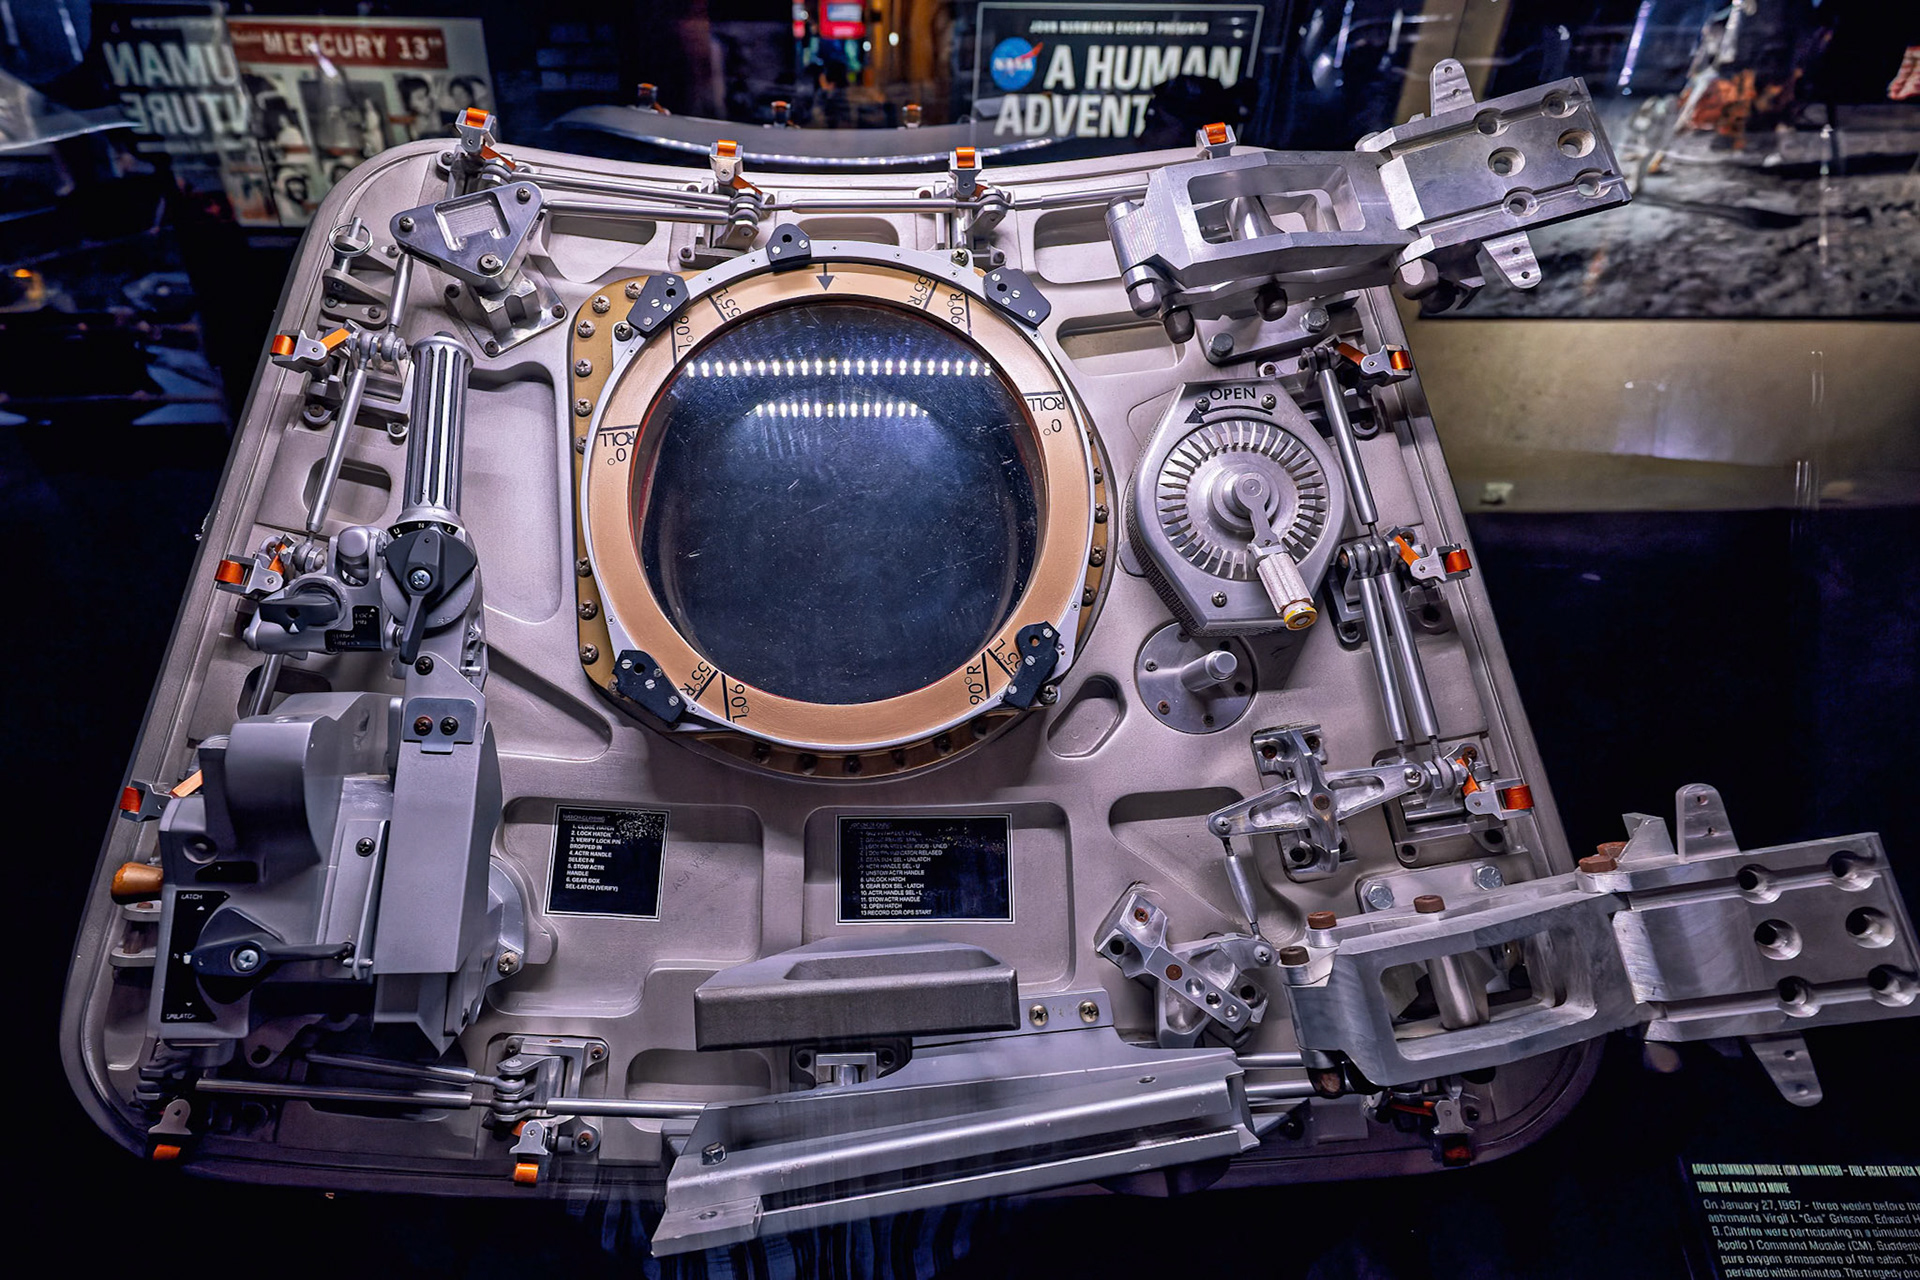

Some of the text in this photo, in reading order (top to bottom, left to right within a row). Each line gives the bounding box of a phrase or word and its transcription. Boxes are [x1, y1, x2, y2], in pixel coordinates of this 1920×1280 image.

[262, 31, 387, 59] MERCURY
[993, 56, 1033, 71] NASA
[1043, 44, 1242, 91] A HUMAN
[1209, 387, 1256, 400] OPEN
[1027, 396, 1065, 411] ROLL
[599, 430, 635, 447] ROLL
[1692, 1163, 1718, 1175] APOLLO
[1717, 1163, 1755, 1175] COMMAND
[1754, 1164, 1783, 1176] MODULE
[1818, 1165, 1843, 1176] HATCH
[1887, 1165, 1917, 1177] REPLICA
[1696, 1181, 1718, 1193] FROM
[1717, 1181, 1732, 1193] THE
[1731, 1182, 1759, 1193] APOLLO
[1766, 1182, 1791, 1194] MOVIE
[1703, 1199, 1718, 1210] On
[1720, 1199, 1759, 1211] January
[1778, 1199, 1800, 1211] 1967
[1812, 1201, 1839, 1211] three
[1873, 1201, 1905, 1211] before
[1763, 1213, 1789, 1225] Virgil
[1874, 1213, 1912, 1224] Edward
[1712, 1226, 1723, 1236] B.
[1723, 1225, 1763, 1237] Chaffee
[1764, 1228, 1789, 1237] were
[1790, 1227, 1853, 1239] participating
[1853, 1228, 1864, 1238] in
[1717, 1239, 1748, 1251] Apollo
[1749, 1239, 1755, 1250] 1
[1756, 1239, 1808, 1250] Command
[1808, 1240, 1846, 1251] Module
[1720, 1255, 1745, 1265] pure
[1746, 1255, 1782, 1266] oxygen
[1845, 1253, 1856, 1264] of
[1857, 1254, 1875, 1264] the
[1725, 1267, 1769, 1279] perished
[1770, 1267, 1800, 1278] within
[1801, 1267, 1844, 1278] minutes.
[1843, 1267, 1864, 1278] The
[1864, 1268, 1901, 1280] tragedy
